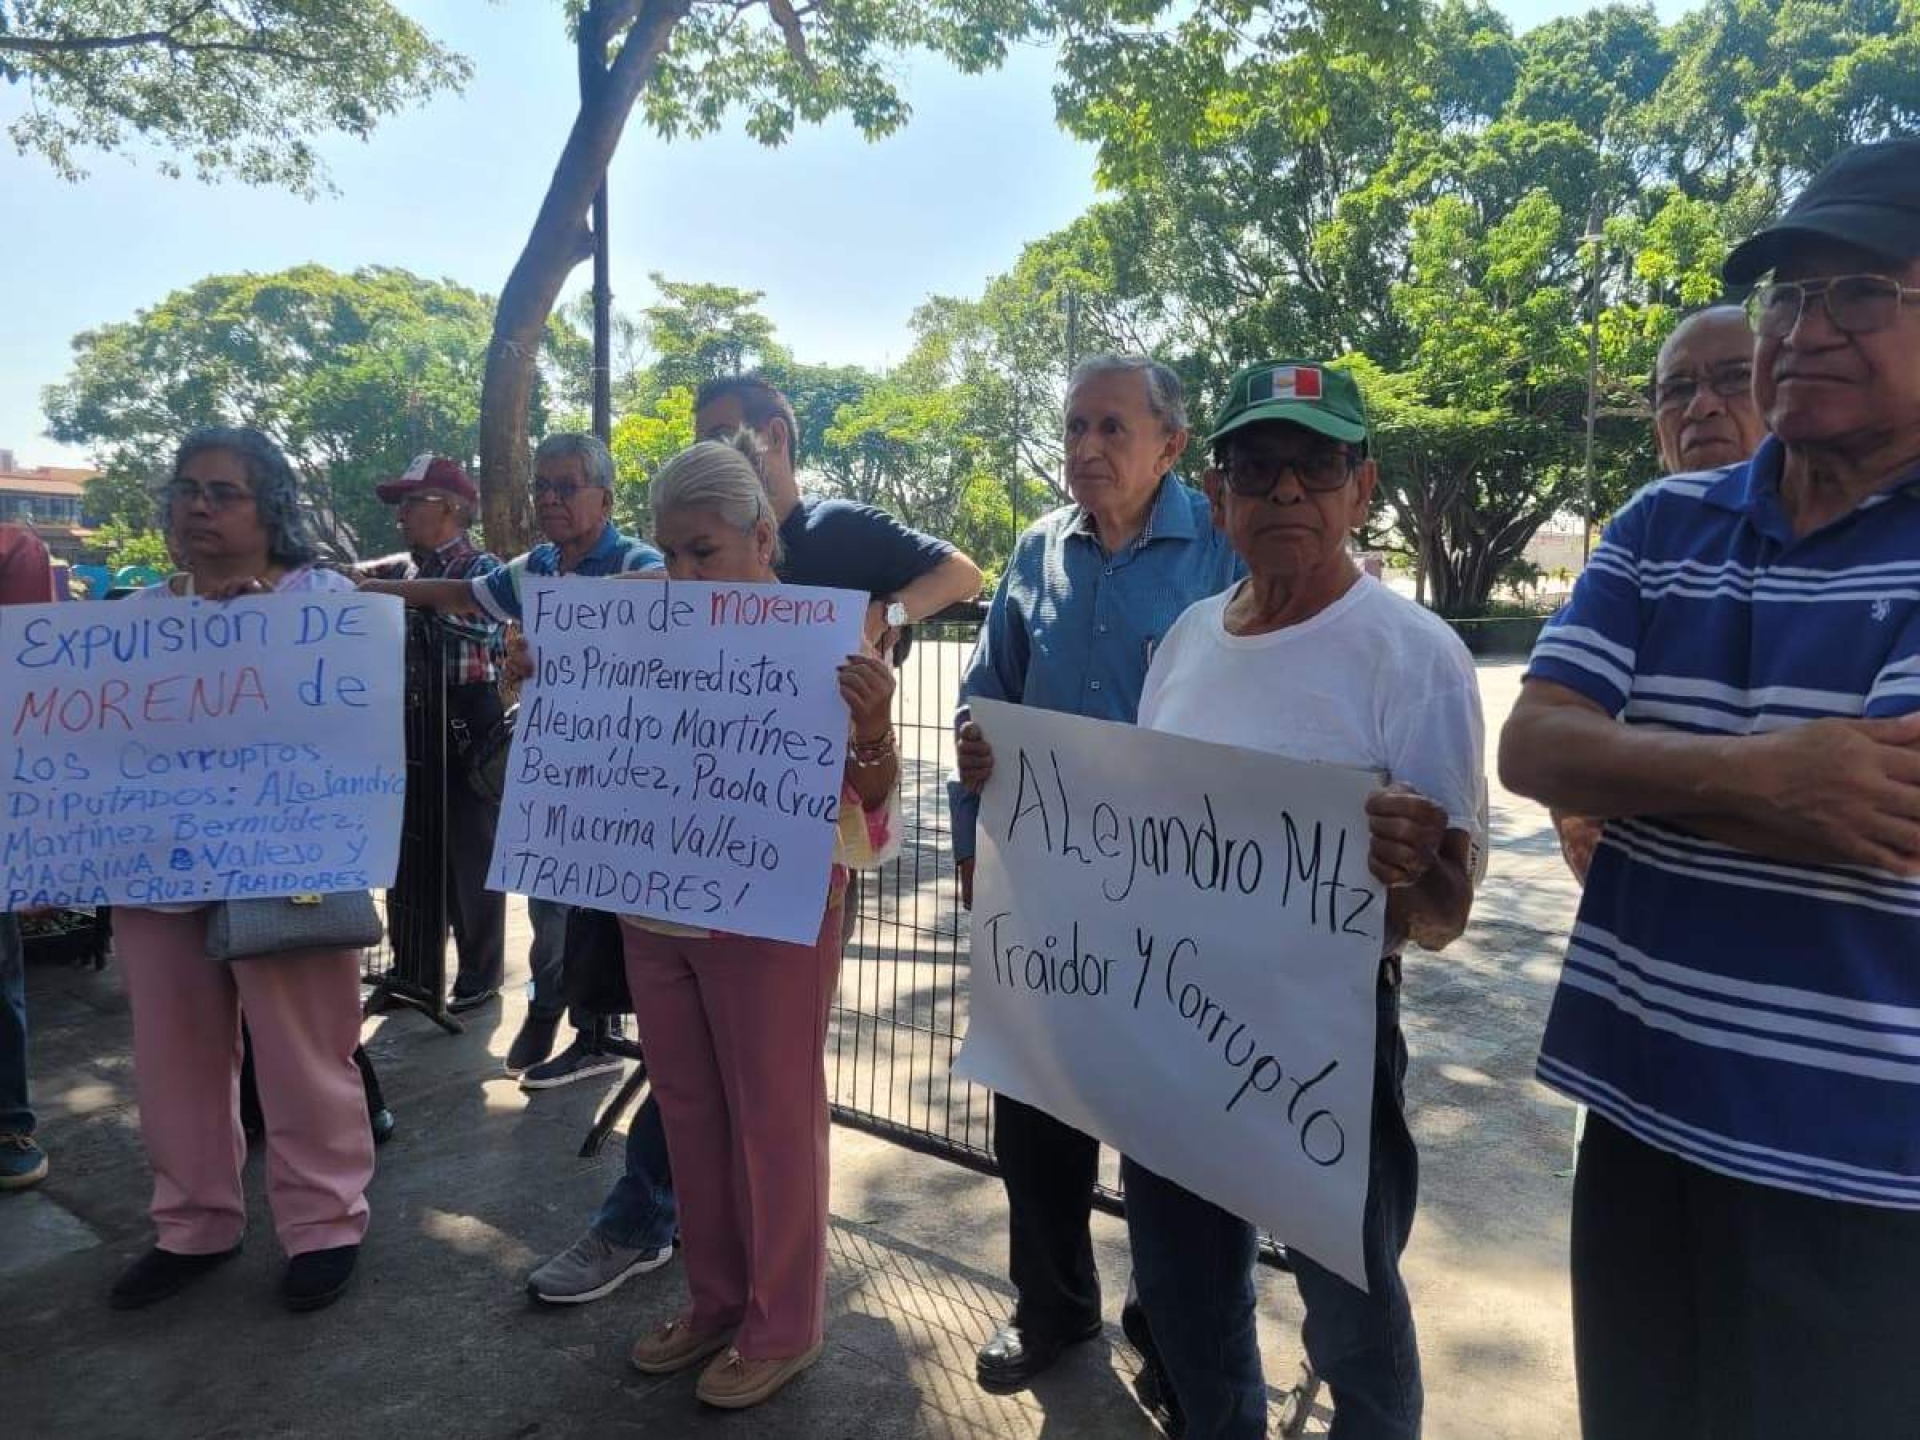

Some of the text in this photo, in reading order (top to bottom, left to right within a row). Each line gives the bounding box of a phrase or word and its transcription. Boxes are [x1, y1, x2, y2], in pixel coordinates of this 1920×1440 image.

[535, 581, 837, 635] Fuera de morena
[13, 657, 371, 736] MORENA de
[522, 695, 835, 767] Alejandro Martínez
[516, 746, 839, 823] Bermúdez, Paola Cruz
[545, 803, 655, 850] Macrina
[671, 813, 780, 872] Vallejo
[217, 869, 369, 898] TRAIDORES
[984, 911, 1117, 997] Traidor
